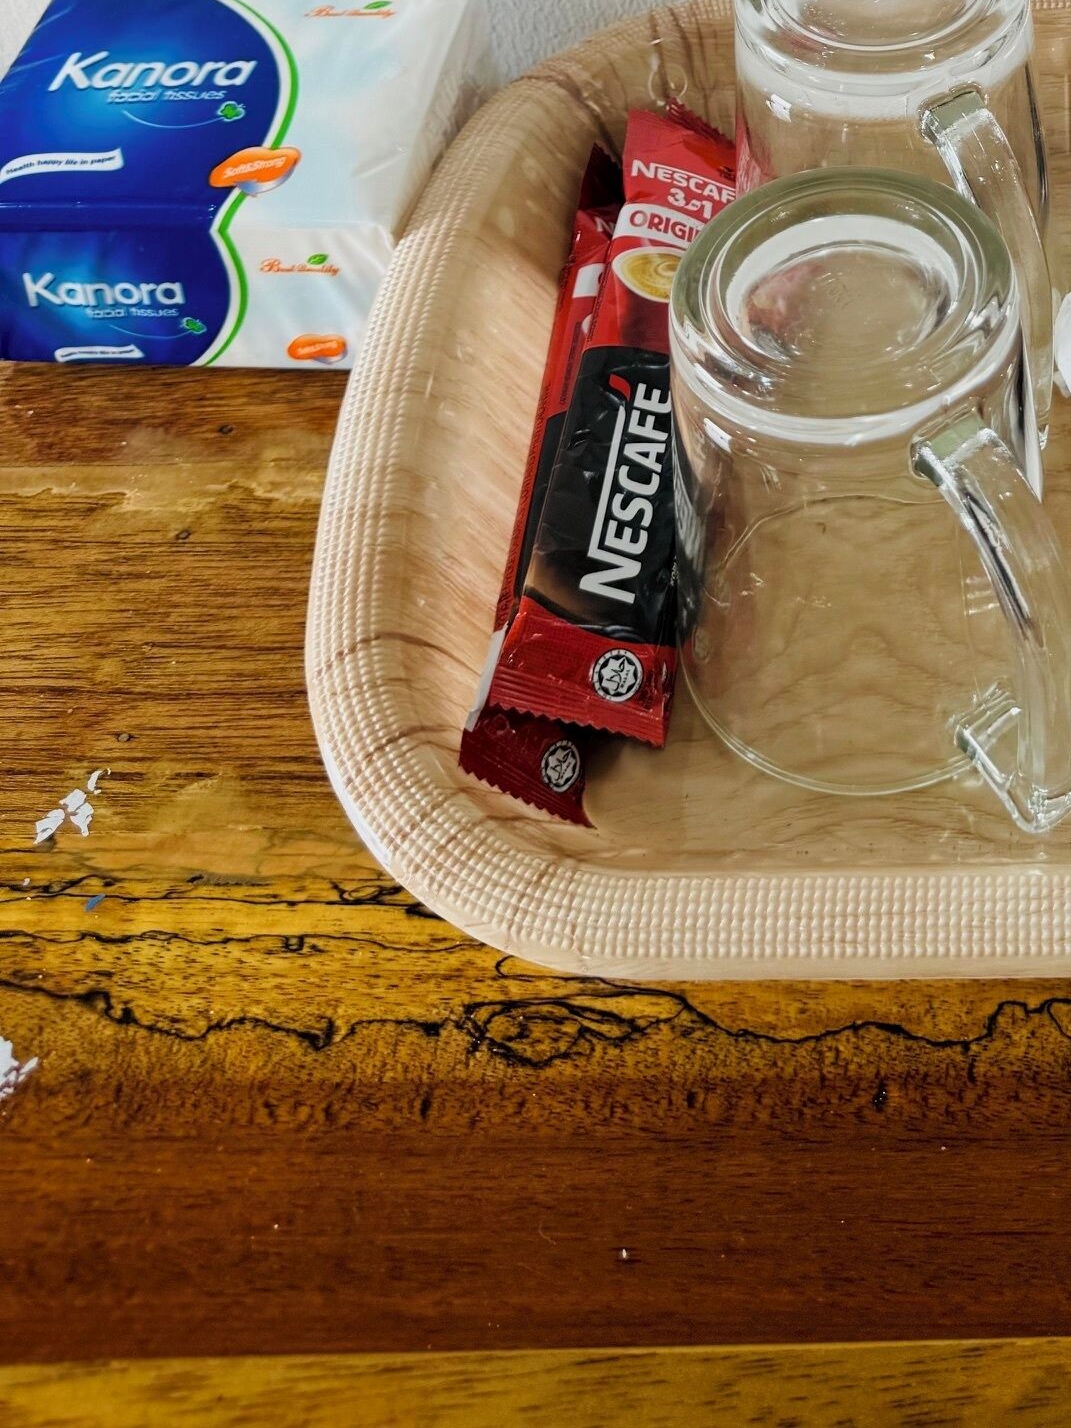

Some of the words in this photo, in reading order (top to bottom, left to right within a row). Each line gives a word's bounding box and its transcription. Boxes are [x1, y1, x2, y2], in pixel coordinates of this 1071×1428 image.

[48, 51, 257, 91] Kanora
[107, 88, 157, 104] facial
[163, 90, 228, 101] tissues
[631, 159, 736, 203] NESCAF
[629, 210, 701, 243] ORIGI
[22, 272, 185, 308] Kanora
[86, 307, 127, 318] facial
[131, 307, 179, 317] tissues
